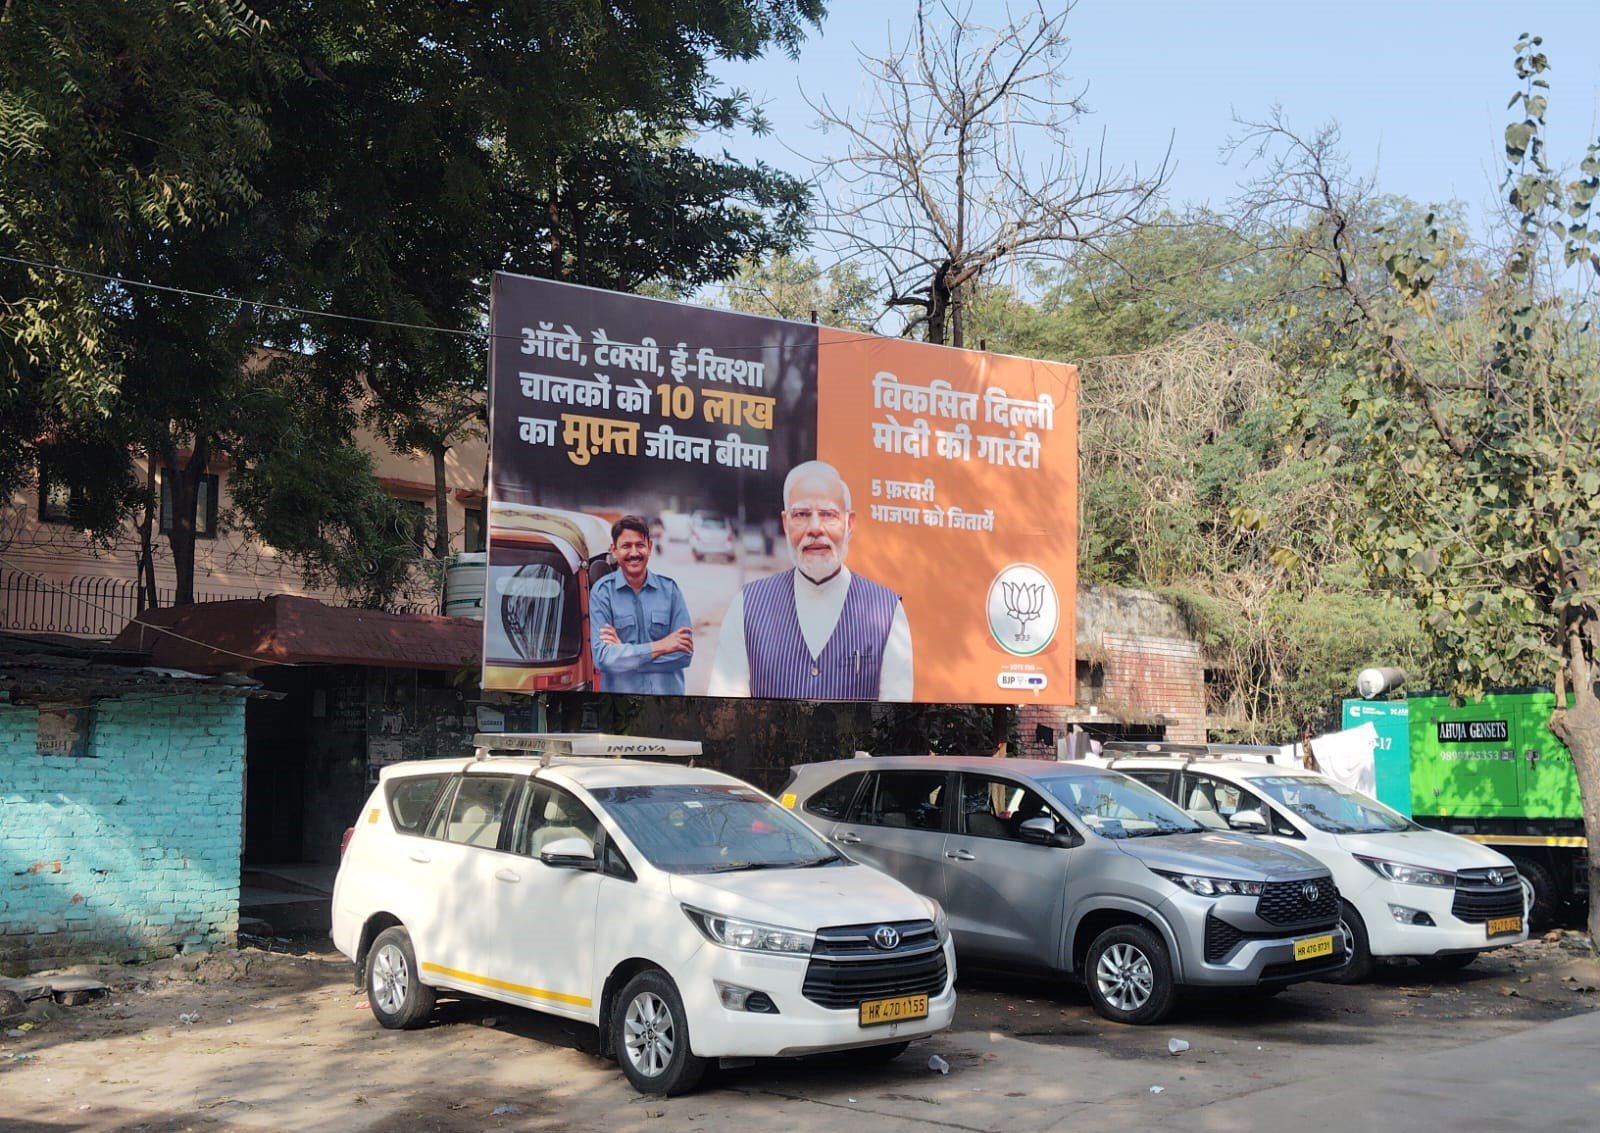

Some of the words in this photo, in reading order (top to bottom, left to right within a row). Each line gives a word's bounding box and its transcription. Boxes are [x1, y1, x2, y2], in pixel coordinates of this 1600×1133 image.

[521, 321, 587, 366] ऑटो,
[592, 328, 664, 377] टैक्सी,
[670, 342, 765, 387] ई-रिक्शा
[519, 372, 611, 409] चालकों
[616, 379, 652, 415] को
[658, 384, 694, 420] 10
[702, 388, 776, 430] लाख
[872, 371, 978, 421] विकसित
[984, 387, 1055, 430] दिल्ली
[518, 416, 557, 446] का
[644, 425, 711, 464] जीवन
[715, 433, 769, 470] बीमा
[872, 415, 930, 458] मोदी
[935, 424, 971, 461] की
[977, 432, 1040, 468] गारंटी
[872, 479, 881, 497] 5
[870, 504, 920, 525] भाजपा
[923, 505, 944, 528] को
[607, 744, 666, 753] INNOVA
[1439, 722, 1467, 740] AHUJA
[1469, 722, 1506, 738] GENSETS
[869, 1005, 880, 1020] HR
[902, 999, 924, 1014] 1155
